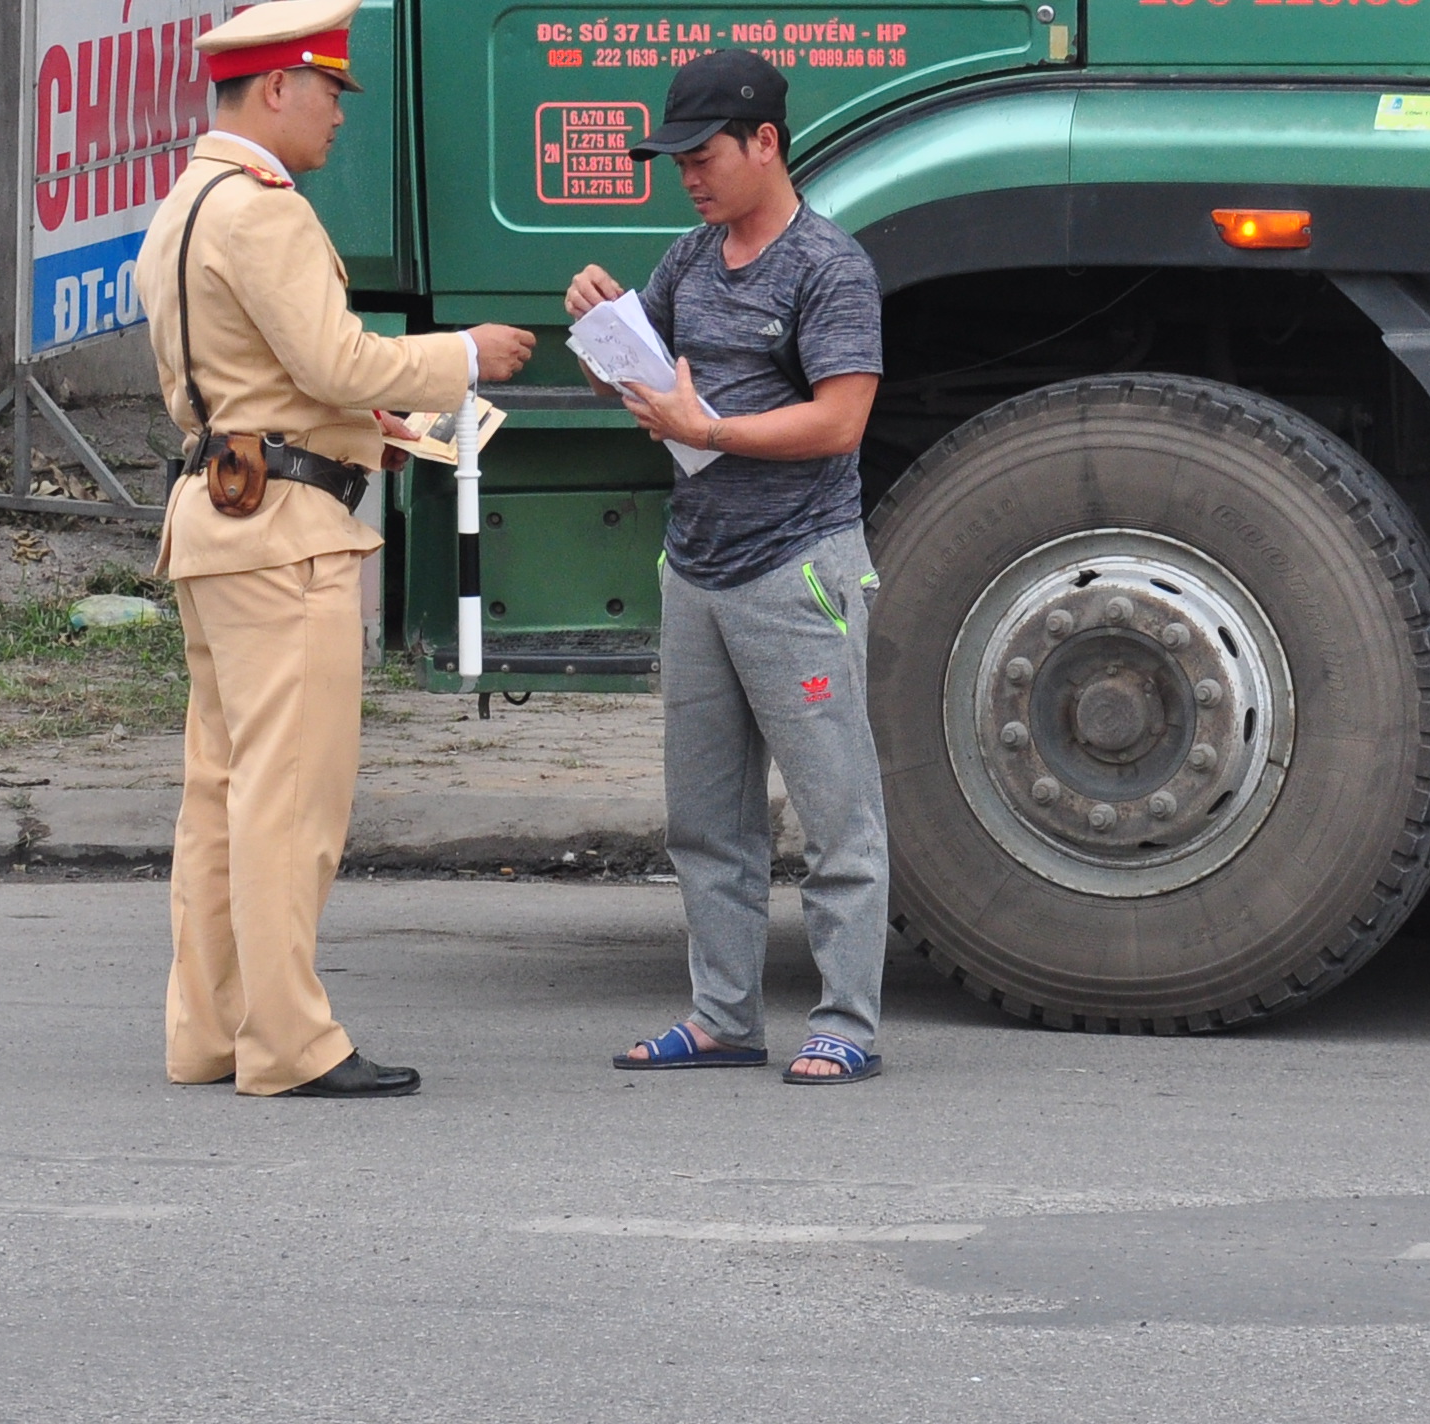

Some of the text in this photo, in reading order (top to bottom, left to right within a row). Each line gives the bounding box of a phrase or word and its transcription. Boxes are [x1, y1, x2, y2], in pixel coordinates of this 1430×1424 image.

[537, 23, 572, 42] ĐC:
[579, 17, 609, 43] SỐ
[614, 23, 641, 43] 37
[646, 19, 671, 42] LÊ
[676, 23, 711, 43] LAI
[731, 18, 777, 43] NGÔ
[876, 23, 907, 43] HP
[625, 48, 658, 67] 1636
[808, 48, 907, 67] 0989.66 66 36
[570, 110, 625, 125] 6.470 KG
[570, 133, 625, 148] 7.275 KG
[571, 156, 633, 171] 13.875 KG
[571, 180, 634, 195] 31.275 KG
[801, 1041, 847, 1058] FILA
